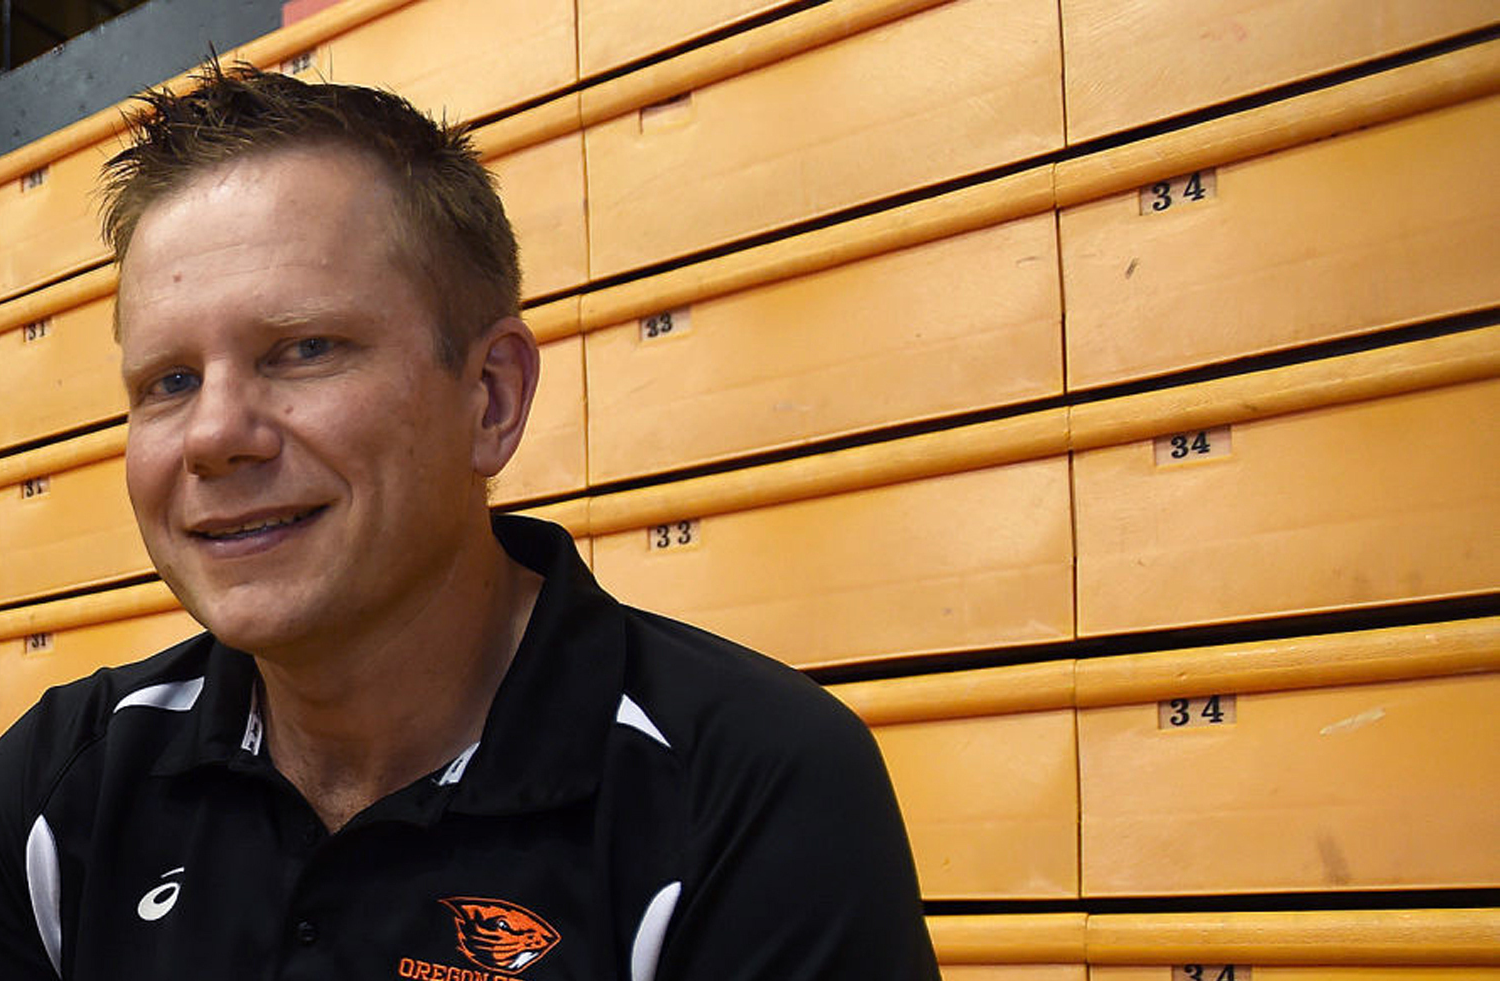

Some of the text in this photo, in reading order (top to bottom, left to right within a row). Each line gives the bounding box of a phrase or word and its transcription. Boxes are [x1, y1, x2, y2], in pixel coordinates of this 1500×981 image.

[1151, 172, 1206, 212] 34
[646, 311, 673, 338] 33
[1170, 430, 1211, 460] 34
[656, 520, 692, 549] 33
[1169, 694, 1225, 726] 34
